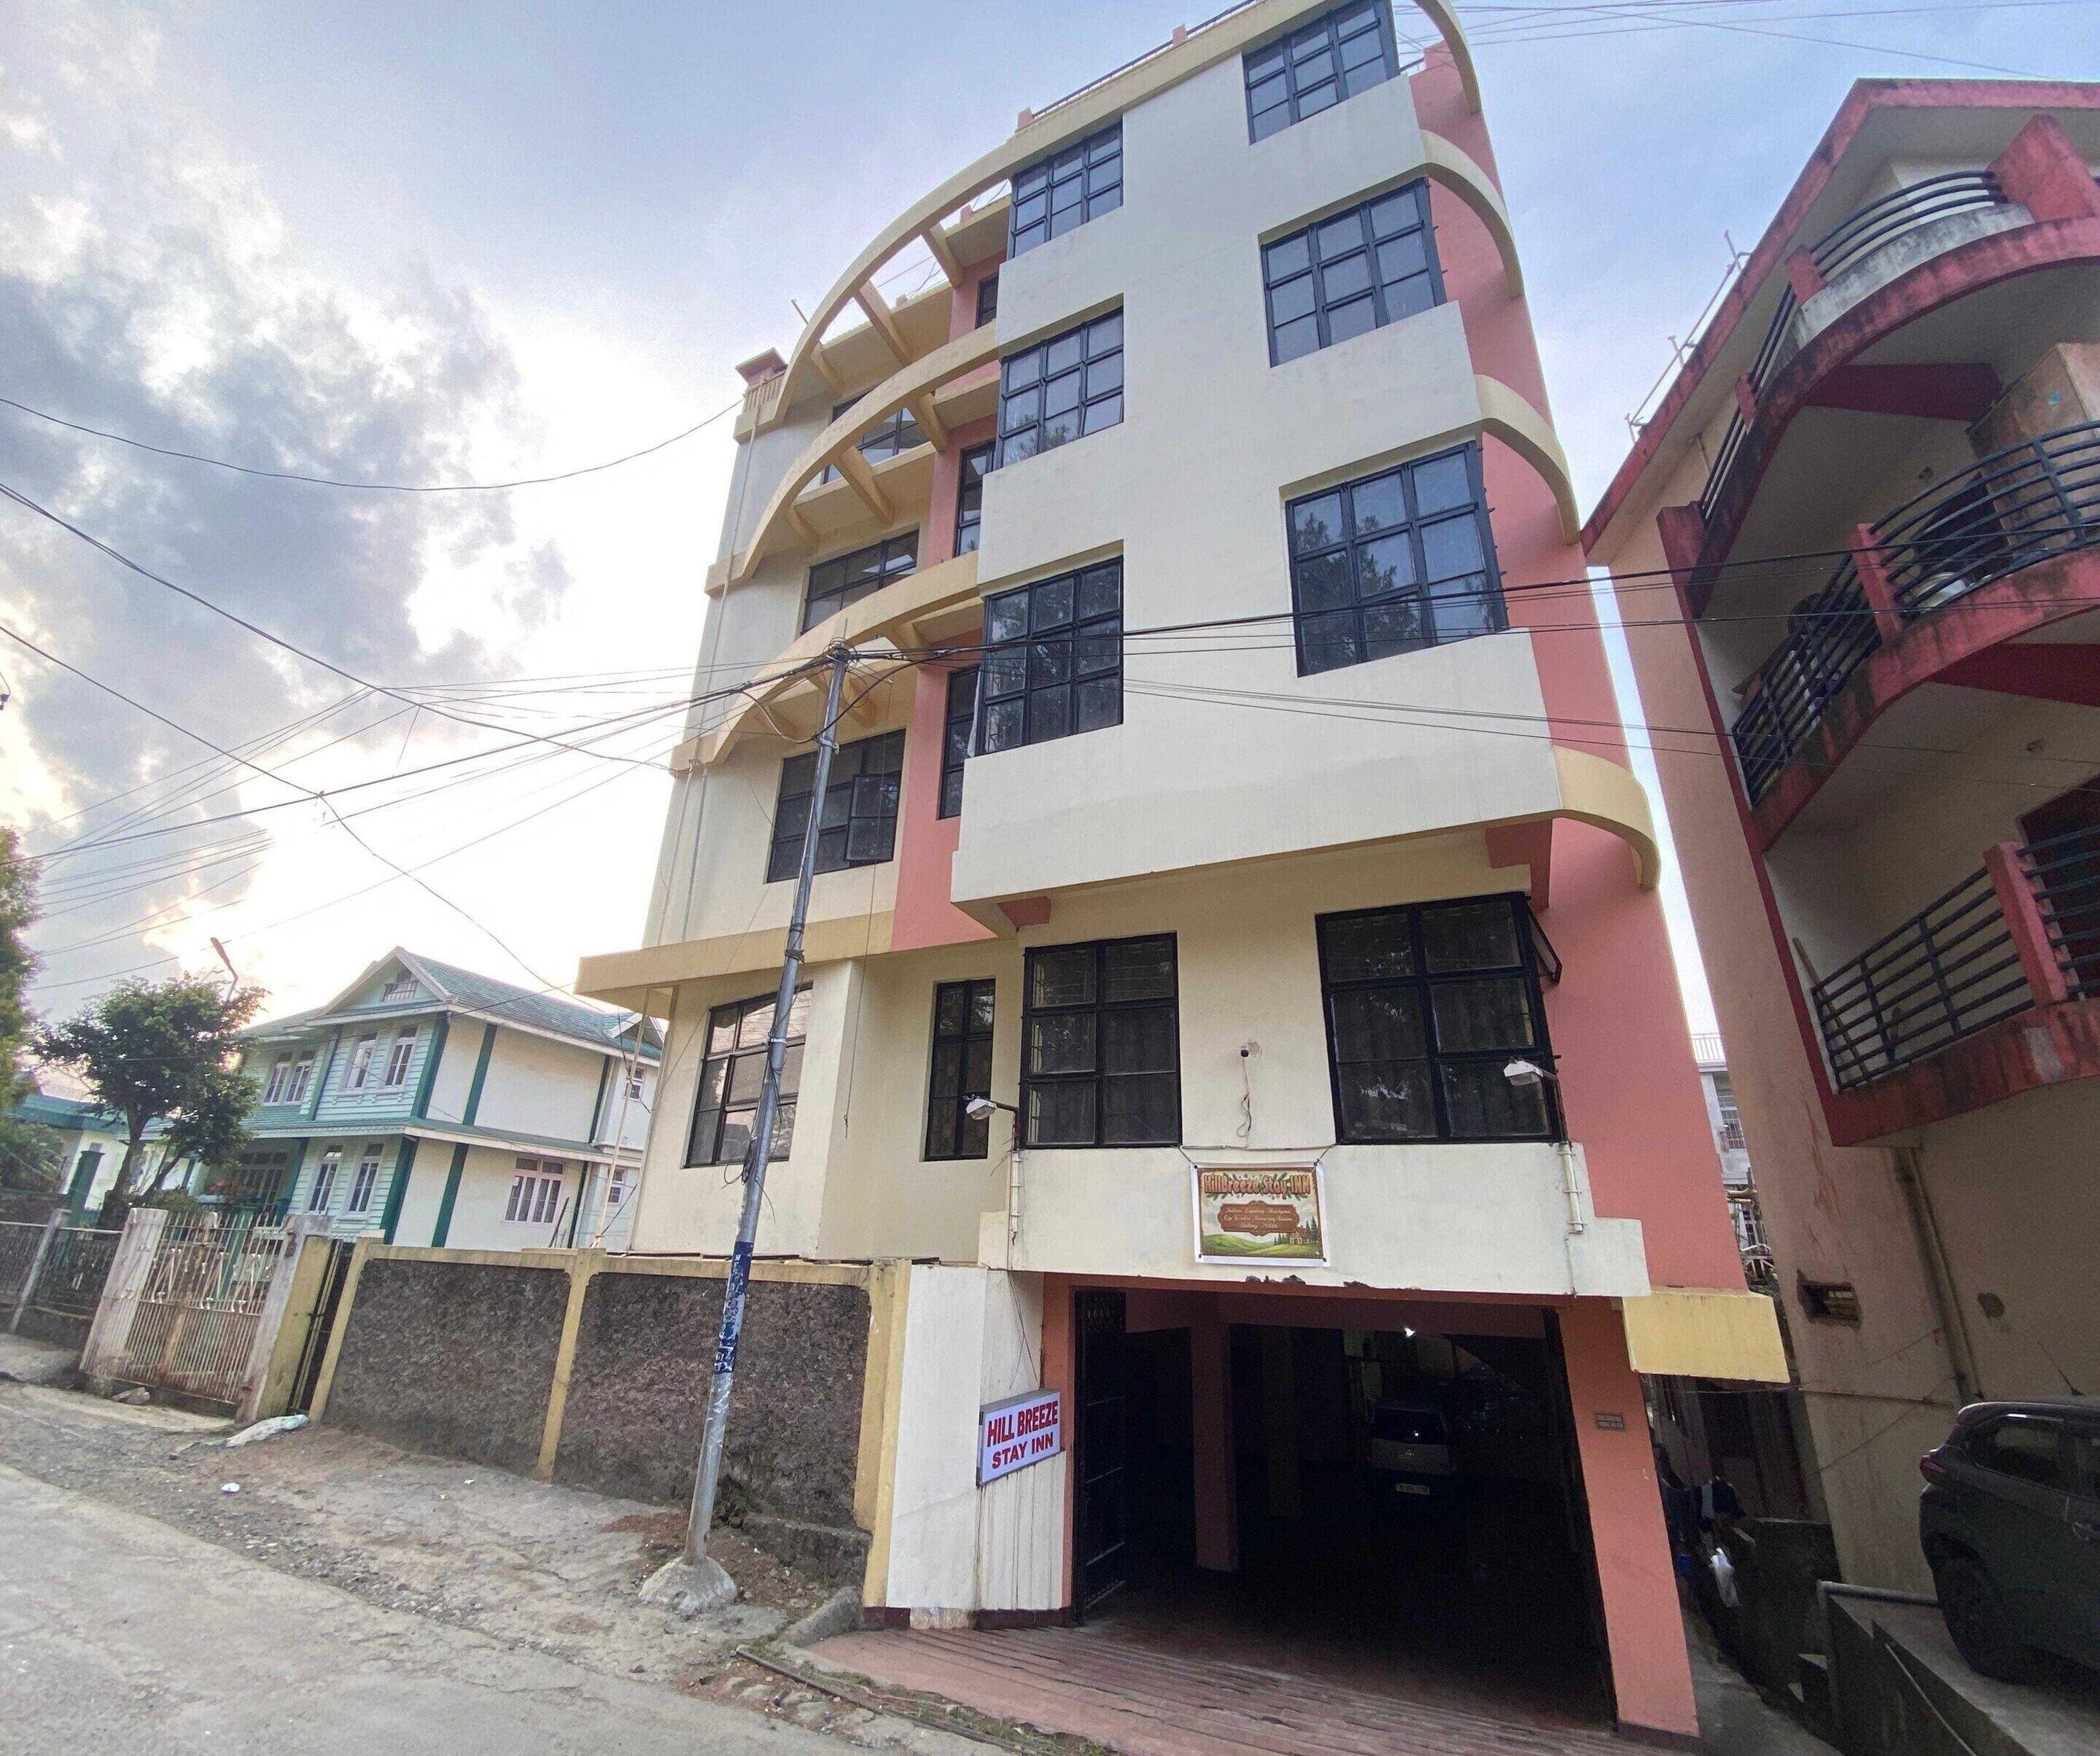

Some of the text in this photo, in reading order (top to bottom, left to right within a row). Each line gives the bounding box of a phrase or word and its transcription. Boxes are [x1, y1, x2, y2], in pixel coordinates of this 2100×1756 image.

[1262, 1175, 1287, 1200] Stay
[1290, 1175, 1311, 1194] INN
[987, 1400, 1059, 1448] HILL BREEZE
[992, 1431, 1054, 1469] STAY INN
